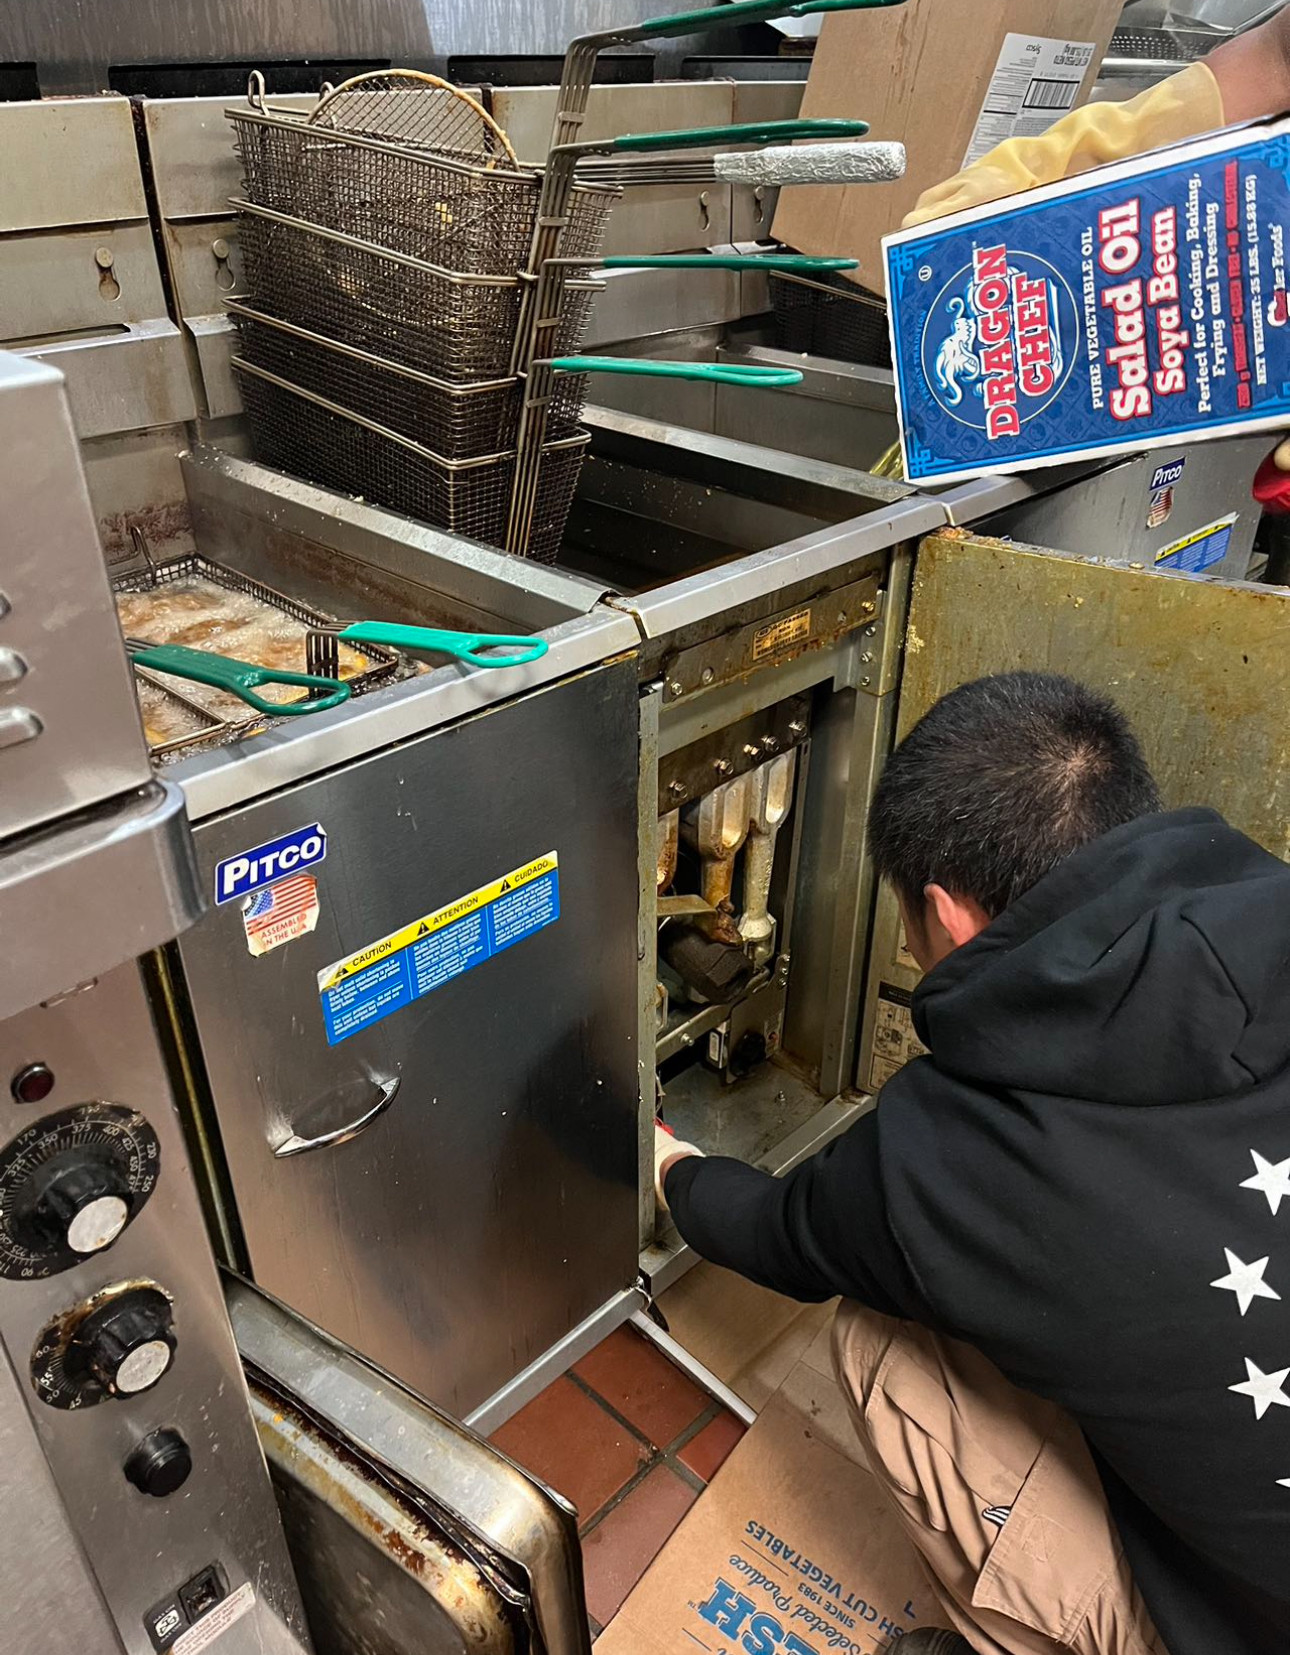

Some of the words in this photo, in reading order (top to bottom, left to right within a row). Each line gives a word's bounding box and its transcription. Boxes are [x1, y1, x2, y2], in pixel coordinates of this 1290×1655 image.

[1185, 173, 1202, 242] Baking,
[1081, 226, 1093, 256] OIL
[1099, 198, 1141, 275] Oil
[1203, 202, 1220, 279] Dressing
[1271, 224, 1284, 269] Foods
[1147, 205, 1179, 307] Bean
[1248, 244, 1260, 277] LBS.
[1188, 243, 1204, 320] Cooking,
[1206, 281, 1221, 315] and
[1250, 277, 1261, 295] 35
[1082, 259, 1100, 361] VEGETABLE
[972, 243, 1020, 440] DRAGON
[1012, 272, 1054, 396] CHEF
[1101, 277, 1151, 421] Salad
[1153, 304, 1190, 396] Soya
[1193, 323, 1206, 348] for
[1210, 319, 1228, 377] Frying
[1089, 364, 1104, 410] PURE
[1195, 351, 1211, 413] Perfect
[1255, 357, 1267, 385] NET
[1151, 464, 1182, 487] PITCO
[223, 836, 322, 895] PITCO
[514, 860, 548, 883] CUIDADO
[433, 896, 479, 926] ATTENTION
[275, 931, 289, 942] THE
[352, 941, 392, 967] CAUTION
[17, 1129, 36, 1146] 170
[38, 1133, 58, 1149] 350
[72, 1123, 91, 1134] 375
[103, 1125, 120, 1136] 400
[122, 1137, 135, 1151] 425
[7, 1158, 26, 1177] 325
[130, 1156, 138, 1172] 450
[141, 1175, 154, 1192] 250
[40, 1371, 54, 1386] 55
[744, 1519, 842, 1599] VEGETABLES
[729, 1554, 793, 1612] Produce
[797, 1582, 822, 1604] 1983
[823, 1601, 856, 1629] SINCE
[842, 1593, 879, 1622] CUT
[790, 1603, 861, 1655] Selected
